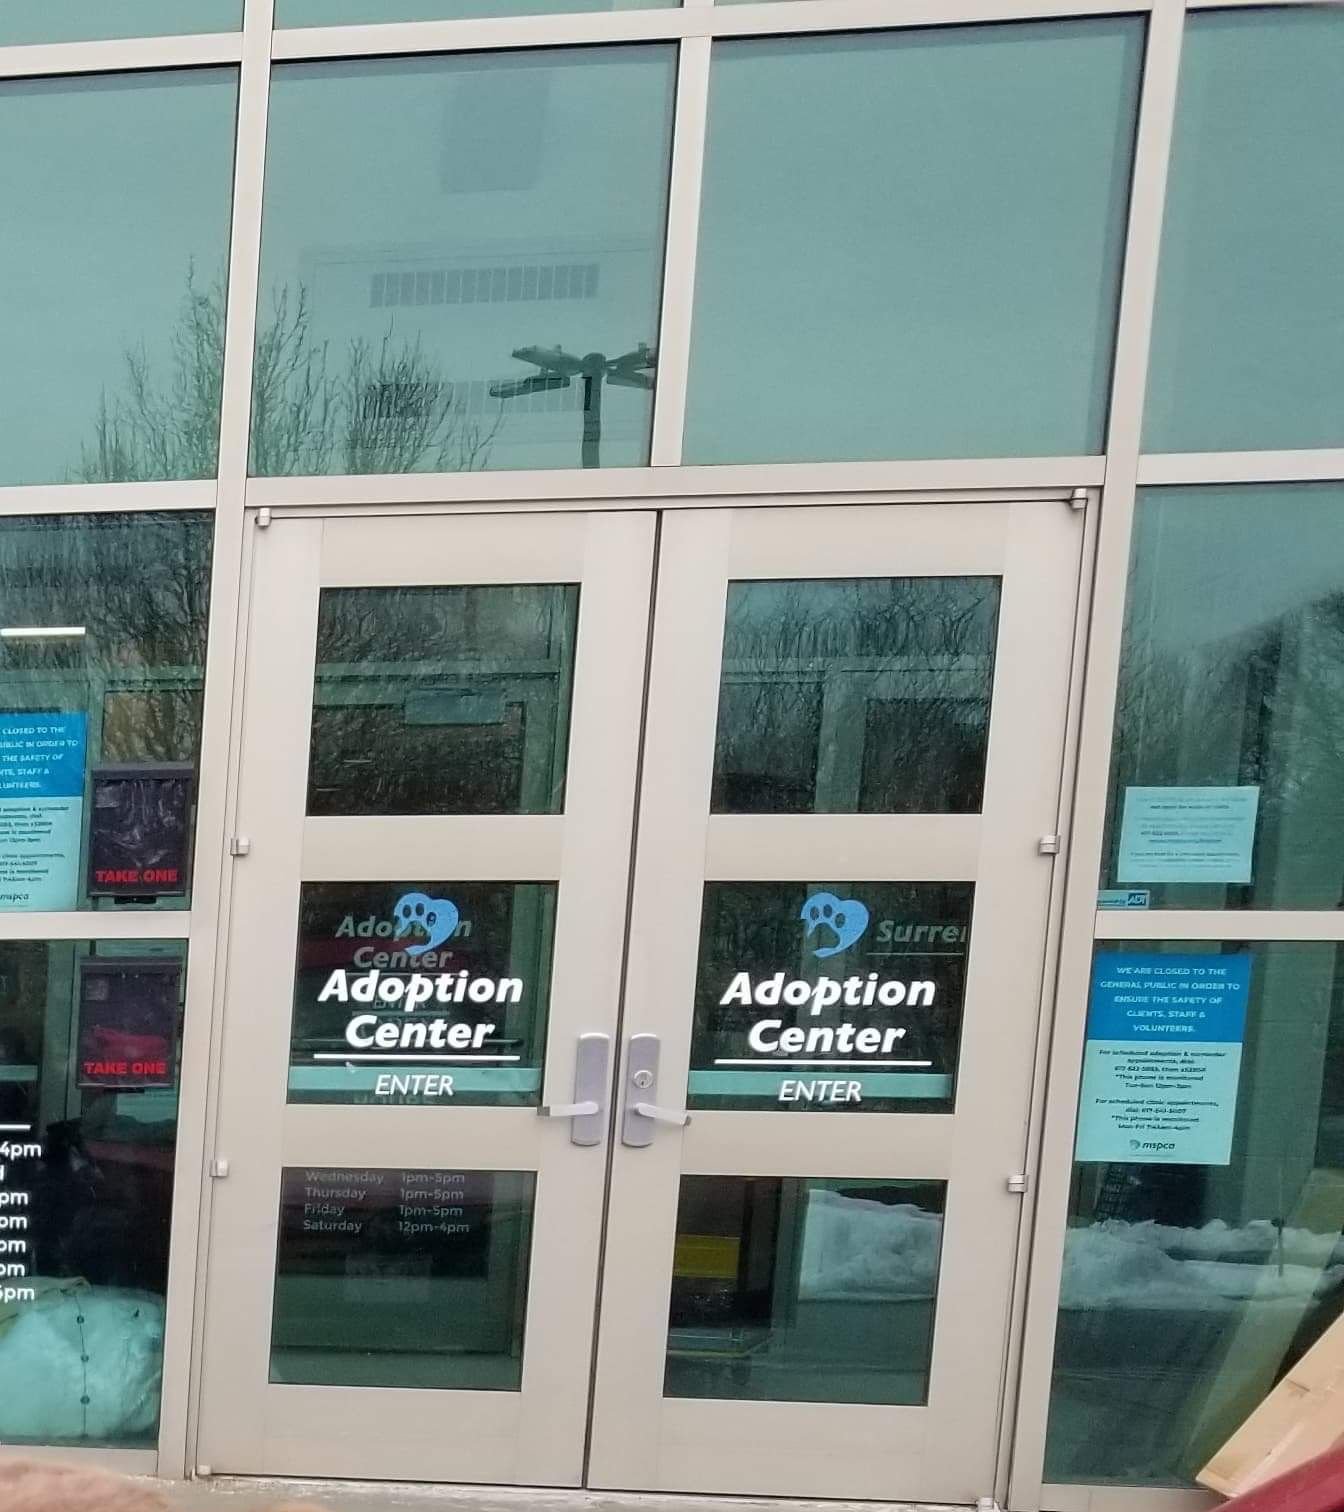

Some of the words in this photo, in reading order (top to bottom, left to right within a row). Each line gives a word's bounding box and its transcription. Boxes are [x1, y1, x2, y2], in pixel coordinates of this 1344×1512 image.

[2, 726, 34, 734] CLOSED
[37, 726, 48, 734] TO
[50, 726, 66, 734] THE
[20, 754, 50, 762] SAFETY
[96, 869, 138, 883] TAKE
[142, 868, 178, 882] ONE
[1207, 968, 1227, 976] THE
[317, 968, 524, 1012] Adoption
[1100, 981, 1142, 989] GENERAL
[1144, 982, 1177, 990] PUBLIC
[1178, 982, 1189, 990] IN
[1191, 982, 1224, 990] ORDER
[720, 972, 936, 1016] Adoption
[1152, 996, 1169, 1004] THE
[1172, 996, 1207, 1004] SAFETY
[1208, 996, 1224, 1004] OF
[1168, 1010, 1197, 1018] STAFF
[345, 1014, 495, 1049] Center
[748, 1020, 906, 1053] Center
[84, 1062, 127, 1074] TAKE
[132, 1062, 166, 1074] ONE
[375, 1074, 454, 1096] ENTER
[778, 1080, 862, 1102] ENTER
[1142, 1142, 1176, 1152] mspca
[306, 1171, 384, 1184] Wednesday
[402, 1172, 465, 1186] 1pm-5pm
[305, 1188, 368, 1200] Thursday
[401, 1188, 464, 1202] 1pm-5pm
[304, 1204, 345, 1216] Friday
[400, 1204, 463, 1218] 1pm-5pm
[304, 1220, 362, 1233] Saturday
[399, 1222, 470, 1234] 12pm-4pm
